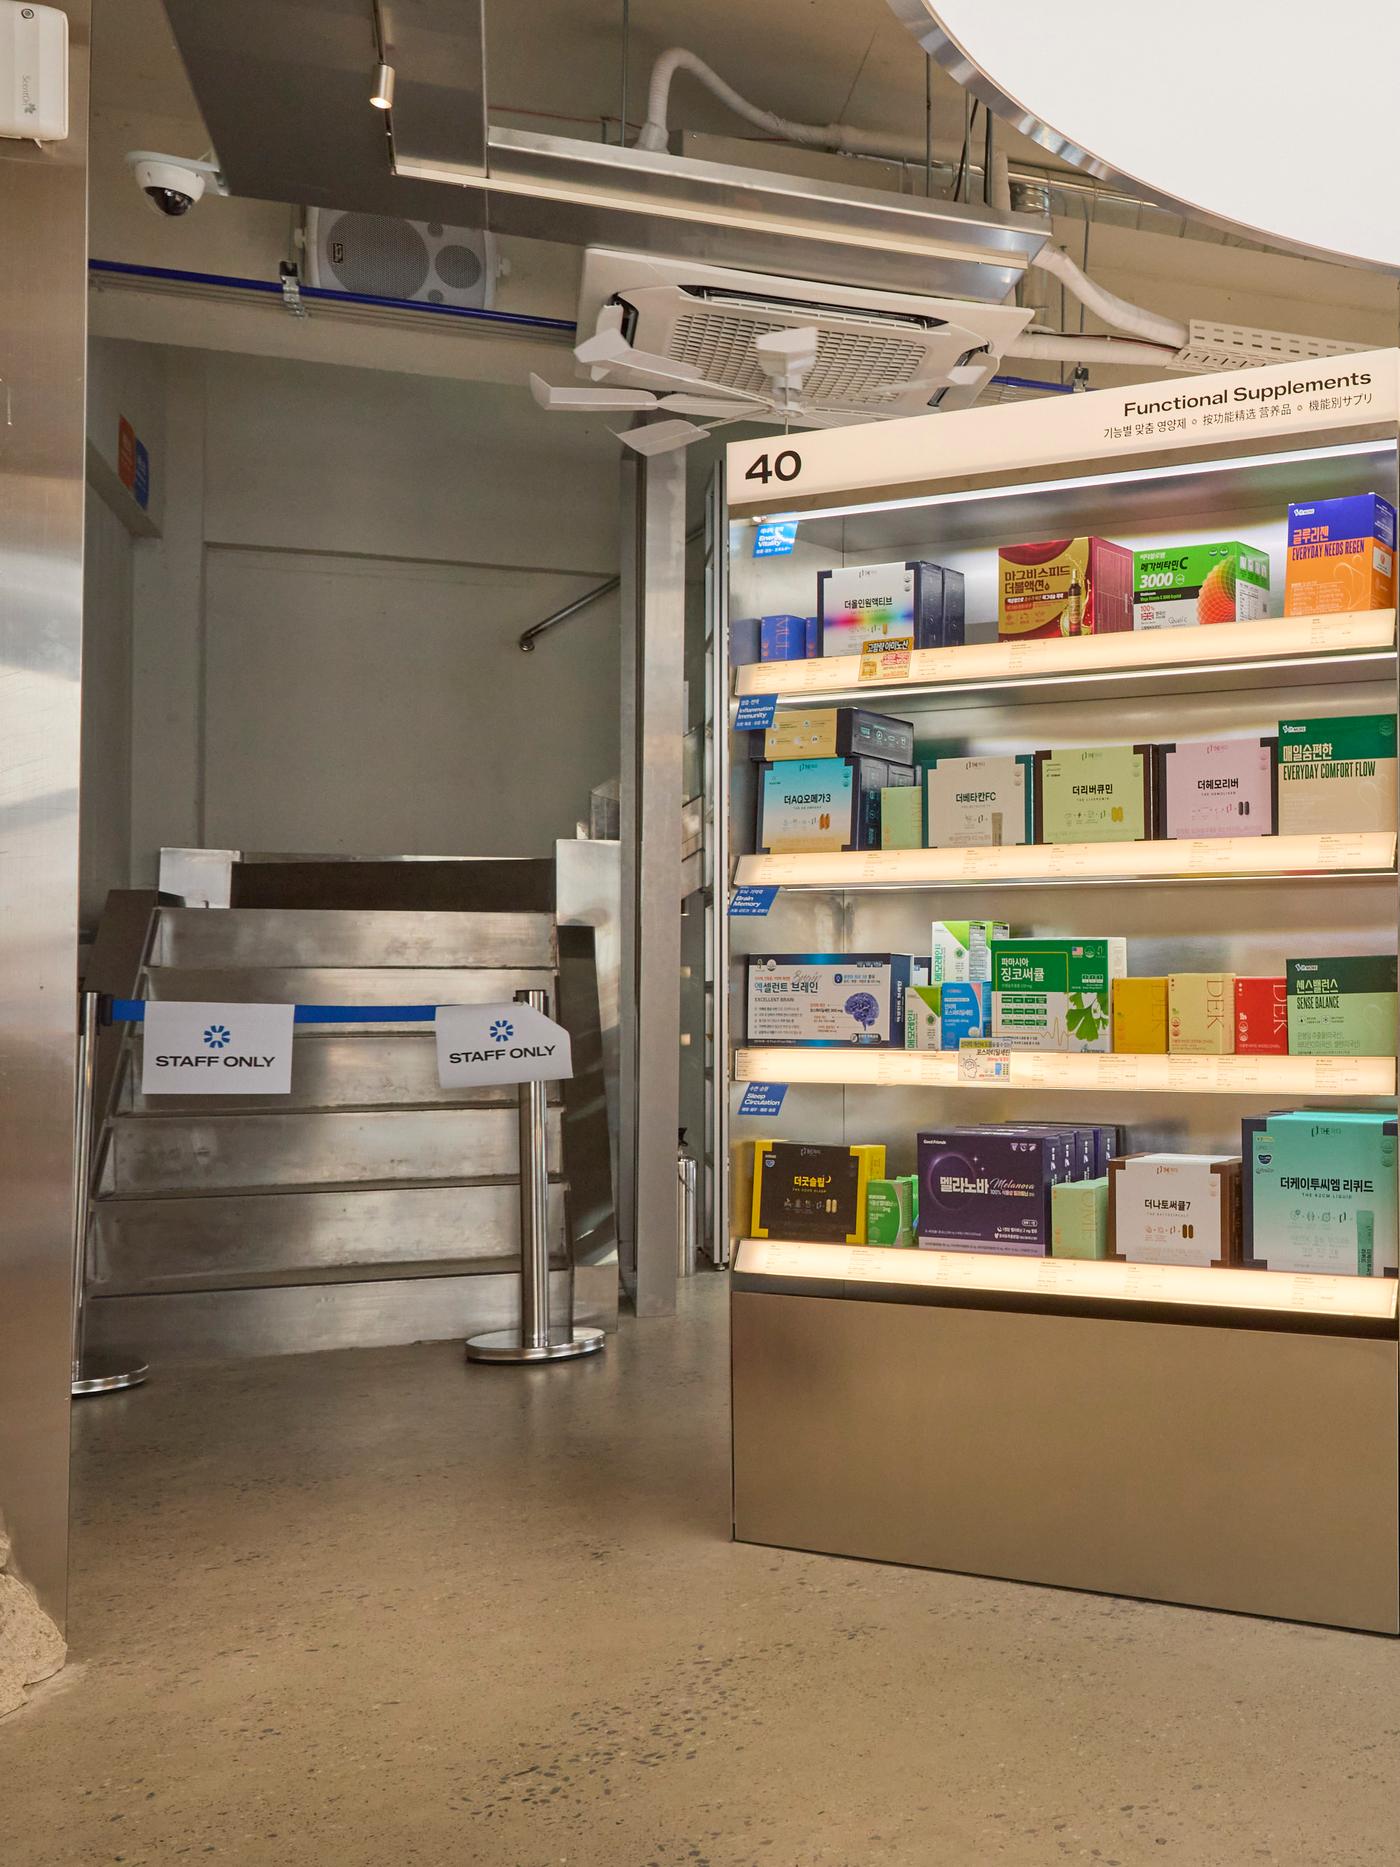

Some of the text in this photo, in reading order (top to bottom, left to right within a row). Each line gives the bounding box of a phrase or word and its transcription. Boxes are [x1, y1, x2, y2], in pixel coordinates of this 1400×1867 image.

[1124, 373, 1372, 417] Functional Supplements
[1308, 393, 1373, 412] 機能別サプリ
[1202, 403, 1292, 426] 按功能精选 营养品
[1103, 418, 1187, 439] 기능별 맞춤 영양제
[745, 450, 802, 484] 40
[1293, 525, 1329, 545] 글루리젠
[1292, 539, 1365, 561] EVERYDAY NEEDS REGEN
[1140, 556, 1189, 572] 메가비타민C
[1004, 565, 1071, 581] 마그비스피드
[1139, 572, 1174, 589] 3000
[1004, 578, 1045, 594] 더블액션
[844, 596, 893, 610] 더올인원액티브
[739, 705, 774, 713] Inflammation
[1283, 743, 1333, 761] 매일숨편한
[1283, 759, 1376, 781] EVERYDAY COMFORT FLOW
[1072, 783, 1113, 796] 더리버큐민
[1197, 778, 1239, 790] 더헤모리버
[783, 793, 832, 806] 더AQ오메가3
[955, 791, 997, 804] 더베타칸FC
[1001, 957, 1029, 967] 파마시아
[754, 981, 818, 994] 엑셀런트 브레인
[1296, 979, 1338, 994] 센스밸런스
[1206, 979, 1224, 1029] DEK
[1297, 995, 1340, 1010] SENSE BALANCE
[154, 1055, 276, 1068] STAFF ONLY
[449, 1045, 556, 1065] STAFF ONLY
[794, 1175, 825, 1188] 더굿슬립
[939, 1176, 989, 1195] 멜라노바
[990, 1177, 1035, 1190] Melanova
[1280, 1177, 1374, 1193] 더케이투씨엠 리퀴드
